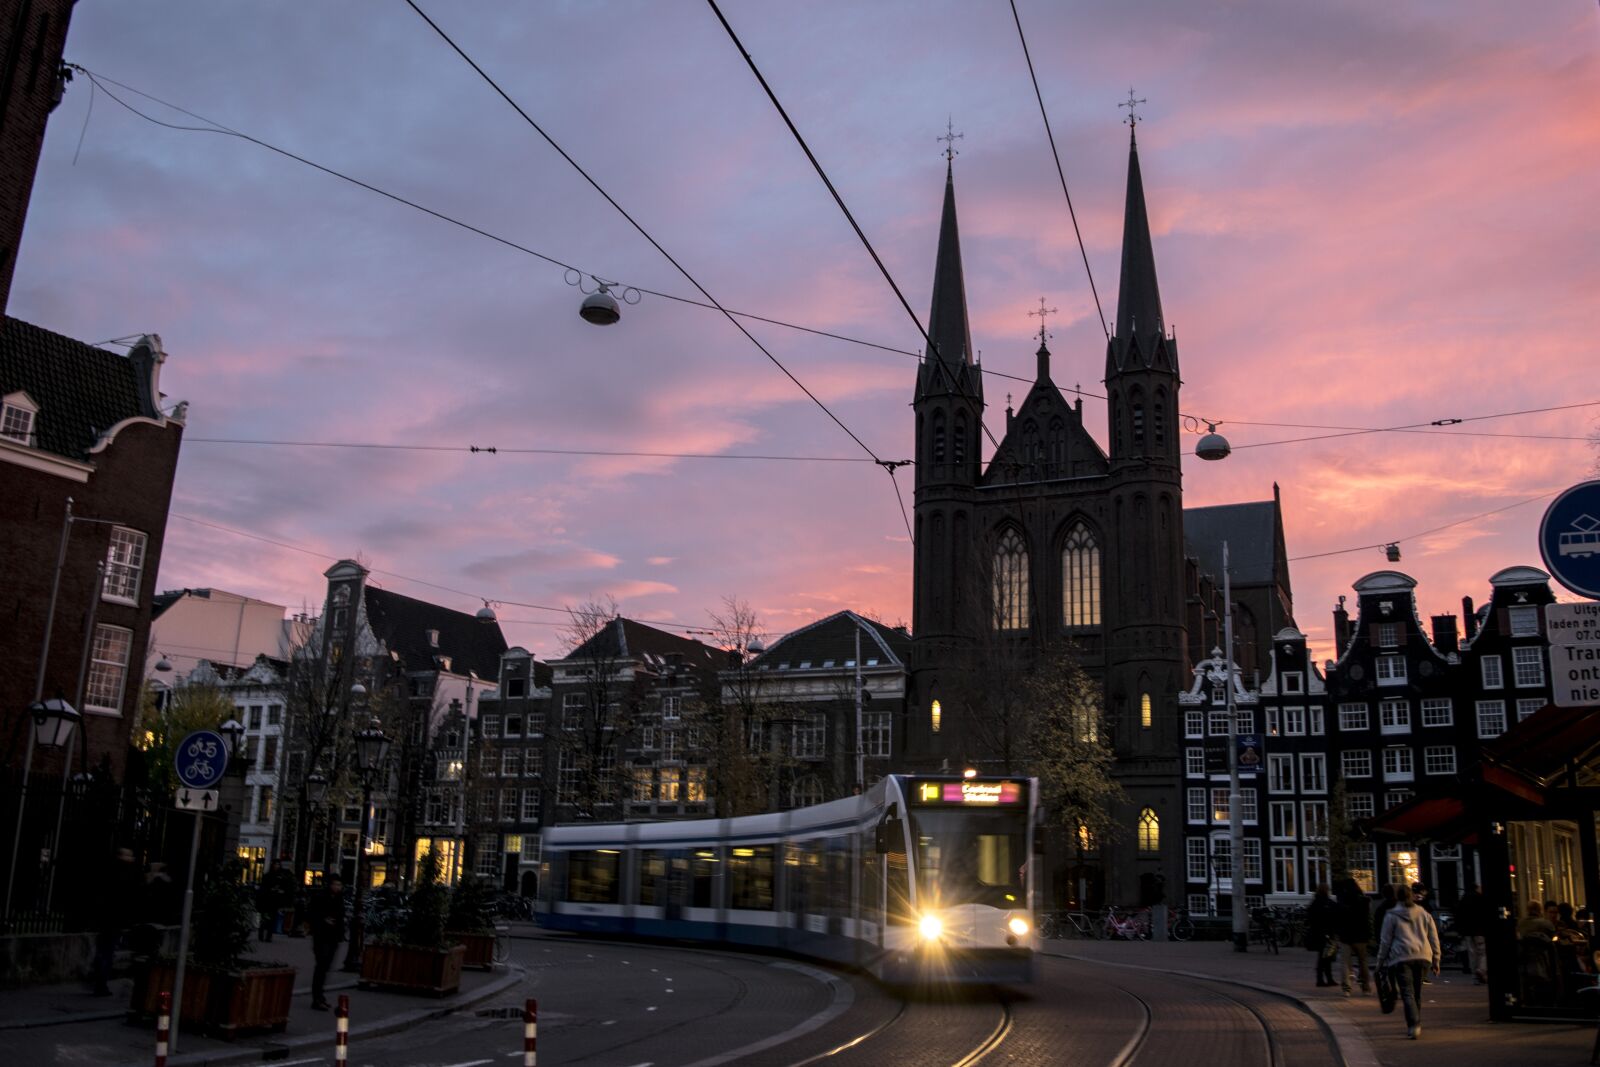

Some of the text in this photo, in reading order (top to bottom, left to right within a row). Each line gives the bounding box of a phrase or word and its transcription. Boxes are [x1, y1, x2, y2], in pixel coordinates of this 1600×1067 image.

[1574, 605, 1600, 616] Uitg
[1549, 619, 1597, 629] laden en
